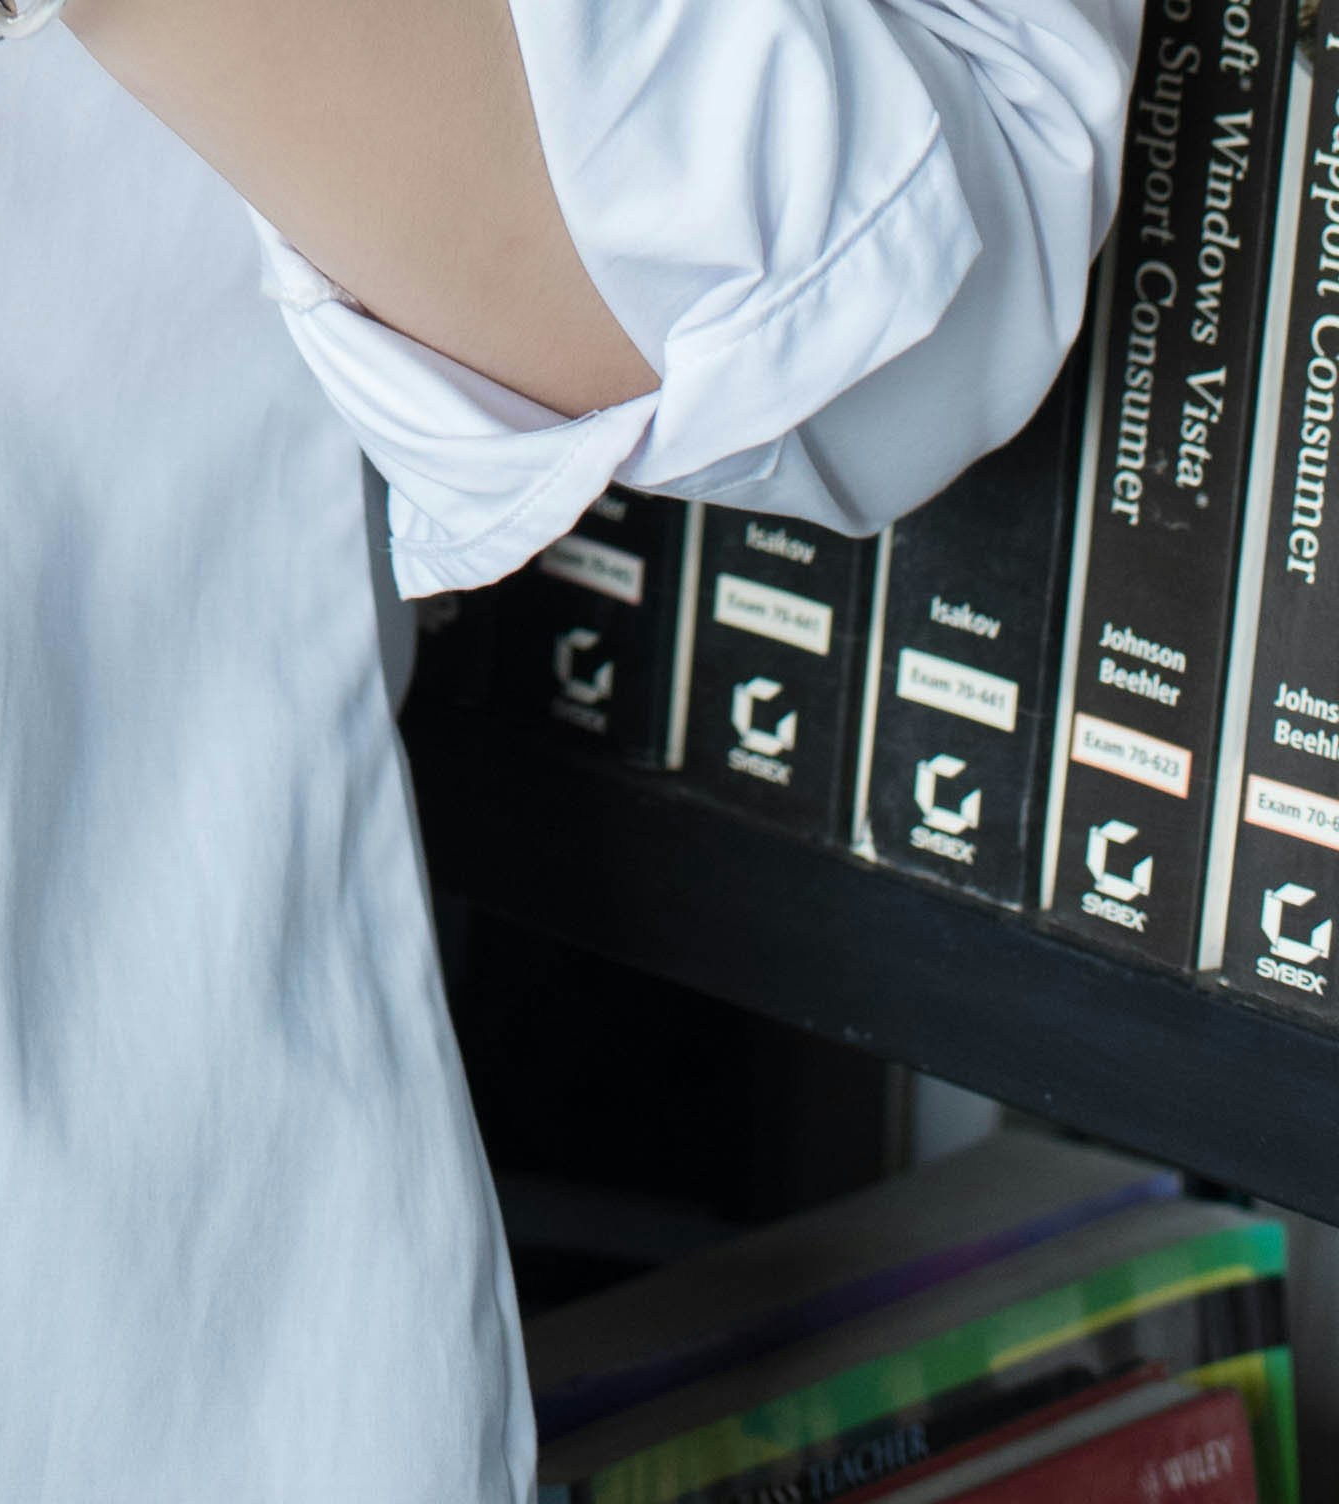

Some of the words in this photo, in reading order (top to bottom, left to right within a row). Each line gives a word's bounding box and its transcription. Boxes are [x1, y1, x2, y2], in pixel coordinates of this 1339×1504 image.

[1136, 35, 1203, 246] Support
[1190, 108, 1256, 347] Windows
[1111, 258, 1179, 528] Consumer
[1175, 364, 1229, 490] Vista
[1287, 312, 1339, 588] Consumer
[745, 521, 816, 566] Isakov
[929, 595, 1001, 640] Isakov
[1098, 621, 1186, 674] Johnson
[909, 666, 952, 694] Exam
[1098, 657, 1182, 708] Beehler
[727, 746, 794, 786] SYBEX
[1084, 730, 1125, 757] Exam
[1129, 741, 1181, 778] 70-623
[1258, 792, 1302, 819] Exam
[909, 822, 977, 866] SYBEX
[1082, 891, 1151, 934] SYBEX
[1255, 955, 1327, 996] SYBEX
